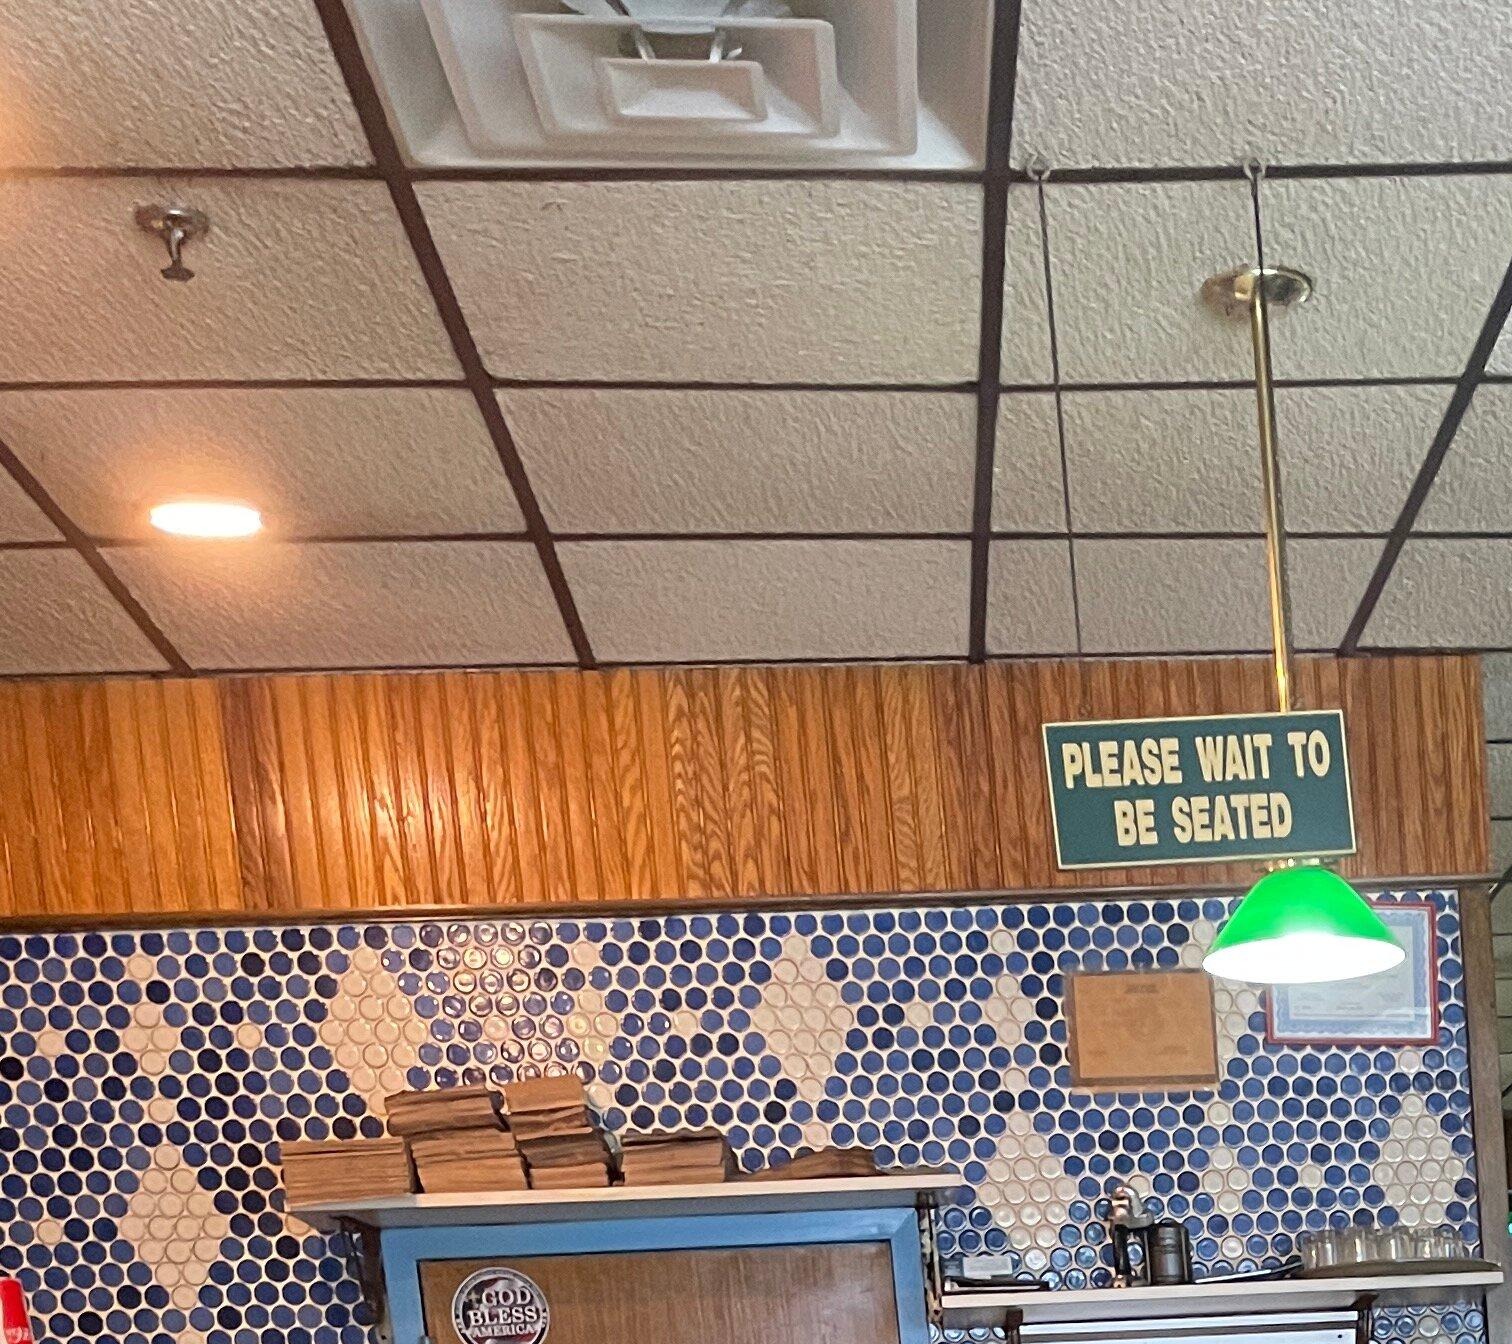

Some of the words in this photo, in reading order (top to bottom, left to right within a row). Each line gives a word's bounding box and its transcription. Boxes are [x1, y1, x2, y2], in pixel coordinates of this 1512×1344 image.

[1062, 737, 1183, 789] PLEASE
[1195, 733, 1272, 782] WAIT
[1287, 730, 1331, 778] TO
[1114, 799, 1158, 847] BE
[1171, 792, 1293, 843] SEATED
[481, 1287, 532, 1306] GOD
[468, 1305, 538, 1326] BLESS
[472, 1323, 534, 1338] AMERICA
